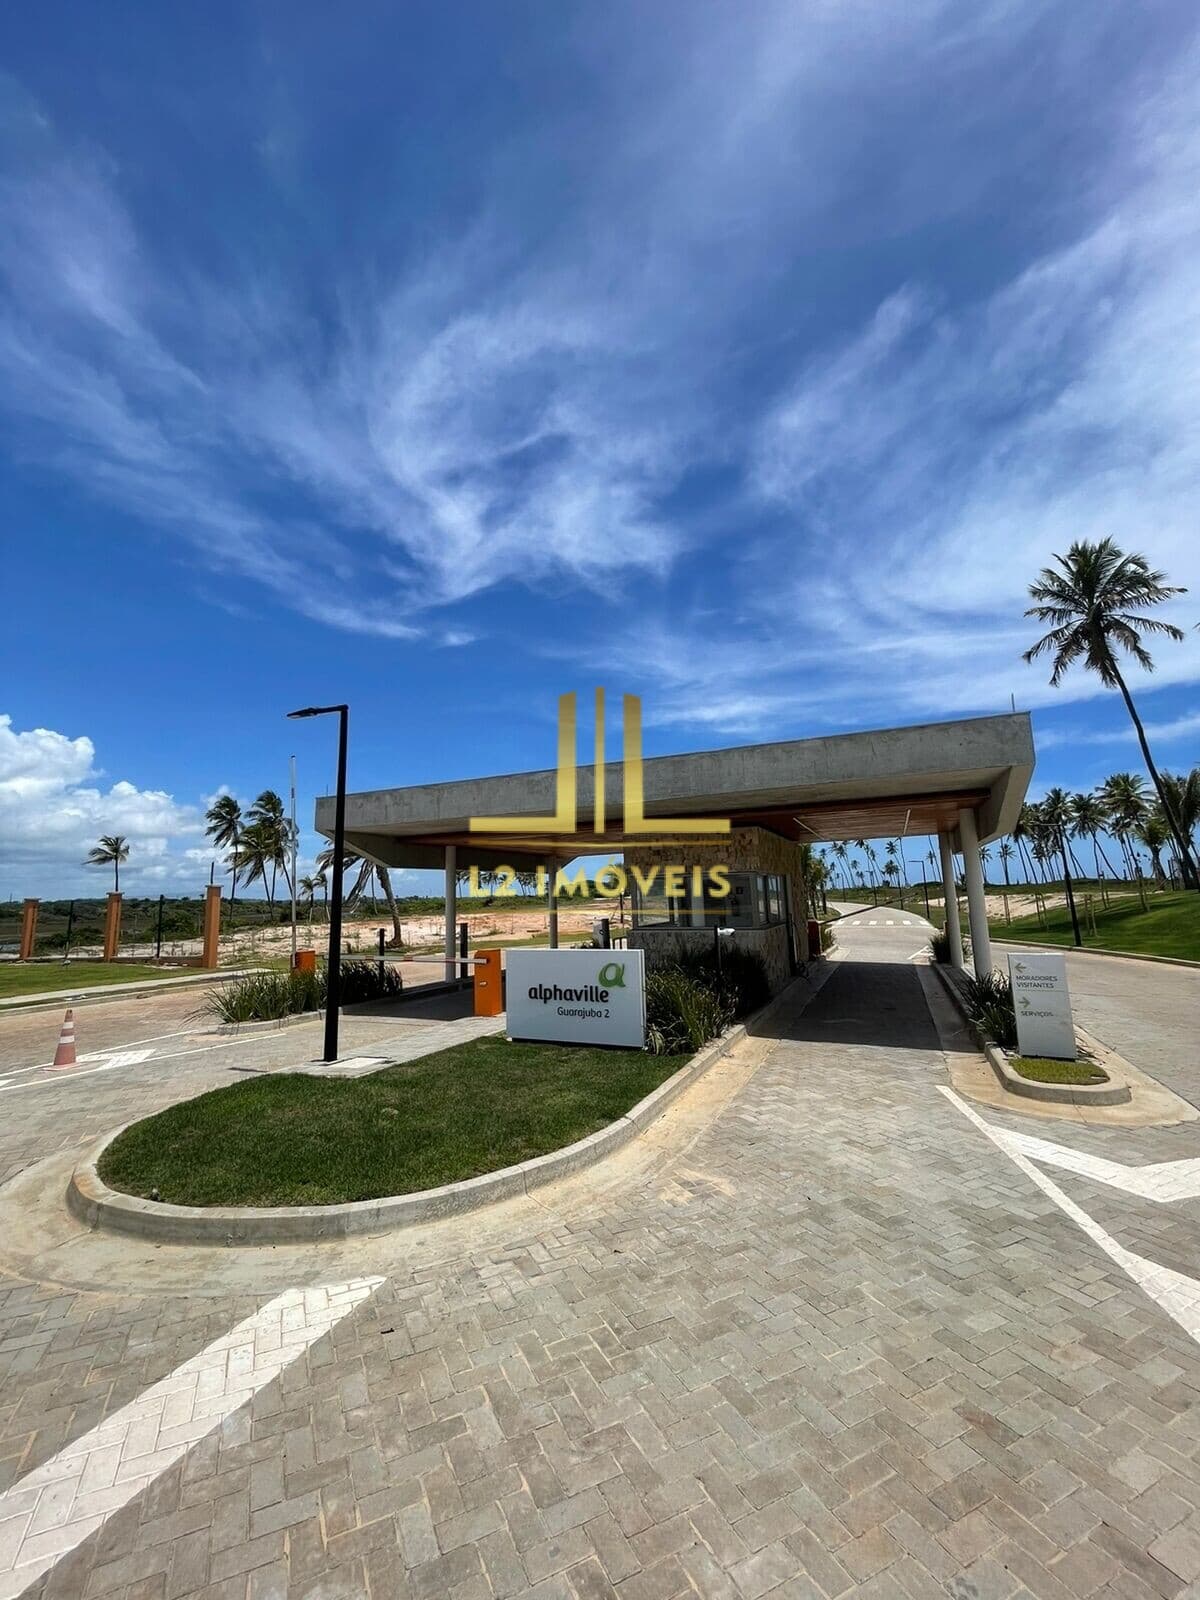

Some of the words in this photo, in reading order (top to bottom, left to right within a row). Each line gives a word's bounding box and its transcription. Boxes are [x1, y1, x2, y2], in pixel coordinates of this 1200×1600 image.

[528, 983, 609, 1004] alphaville
[557, 1006, 602, 1019] Guarajuba
[604, 1009, 610, 1018] 2
